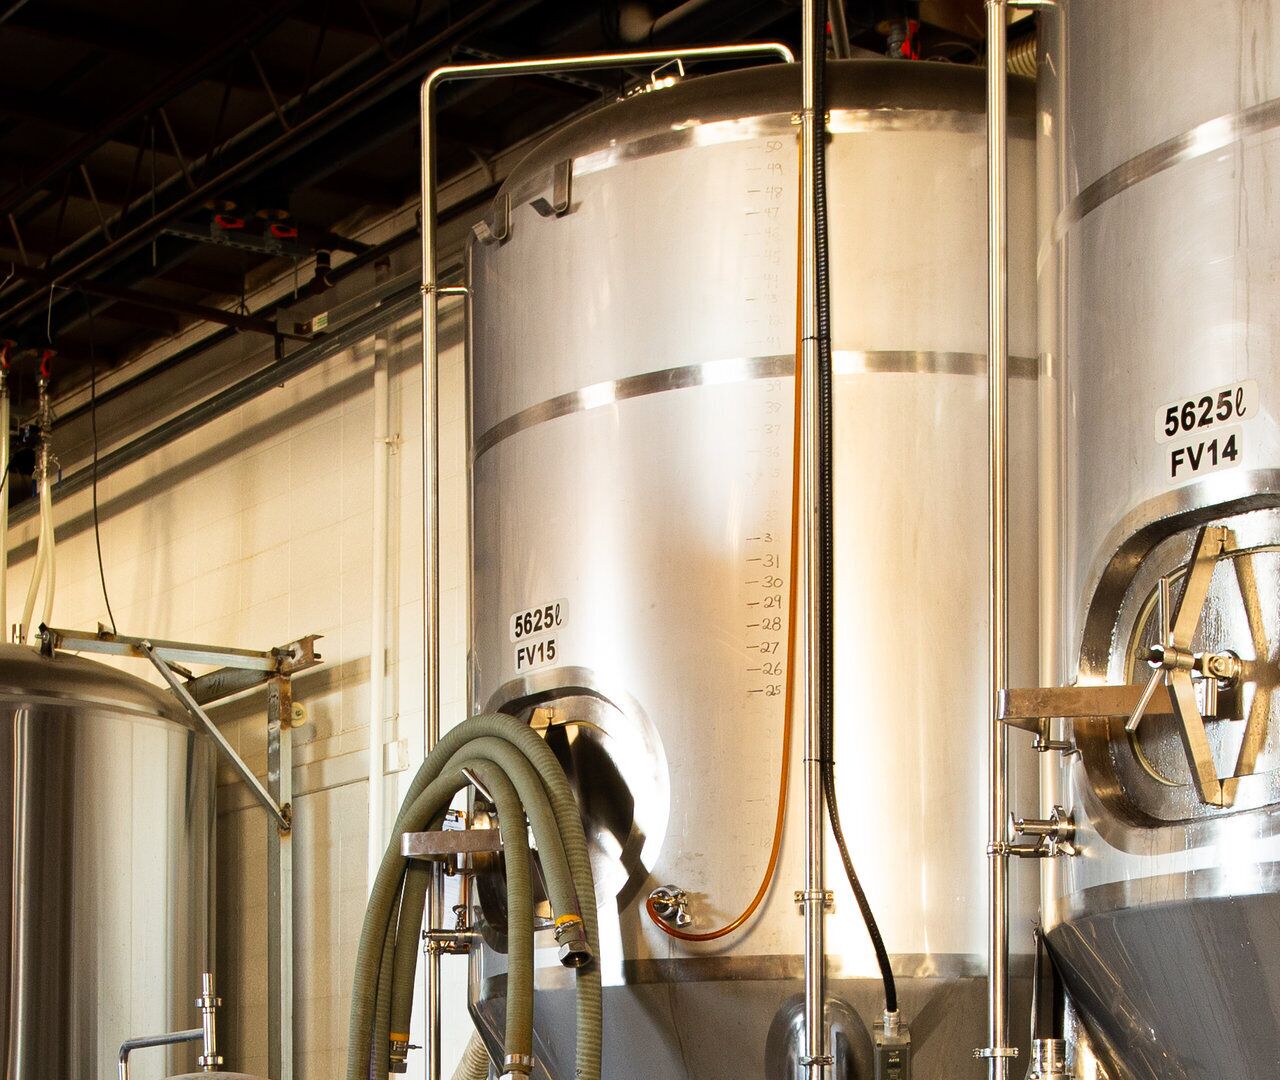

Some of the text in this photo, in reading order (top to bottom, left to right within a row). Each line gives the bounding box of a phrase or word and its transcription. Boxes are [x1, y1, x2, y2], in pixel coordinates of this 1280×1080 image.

[765, 141, 783, 153] 50
[767, 163, 783, 176] 49
[765, 186, 783, 200] 48
[764, 207, 780, 218] 47
[764, 424, 782, 437] 37
[1171, 434, 1238, 477] FV14
[762, 554, 780, 568] 31
[762, 575, 783, 588] 30
[763, 595, 782, 609] 29
[762, 617, 782, 631] 28
[517, 639, 556, 669] FV15
[760, 641, 780, 654] 27
[762, 662, 783, 676] 26
[765, 684, 782, 696] 25
